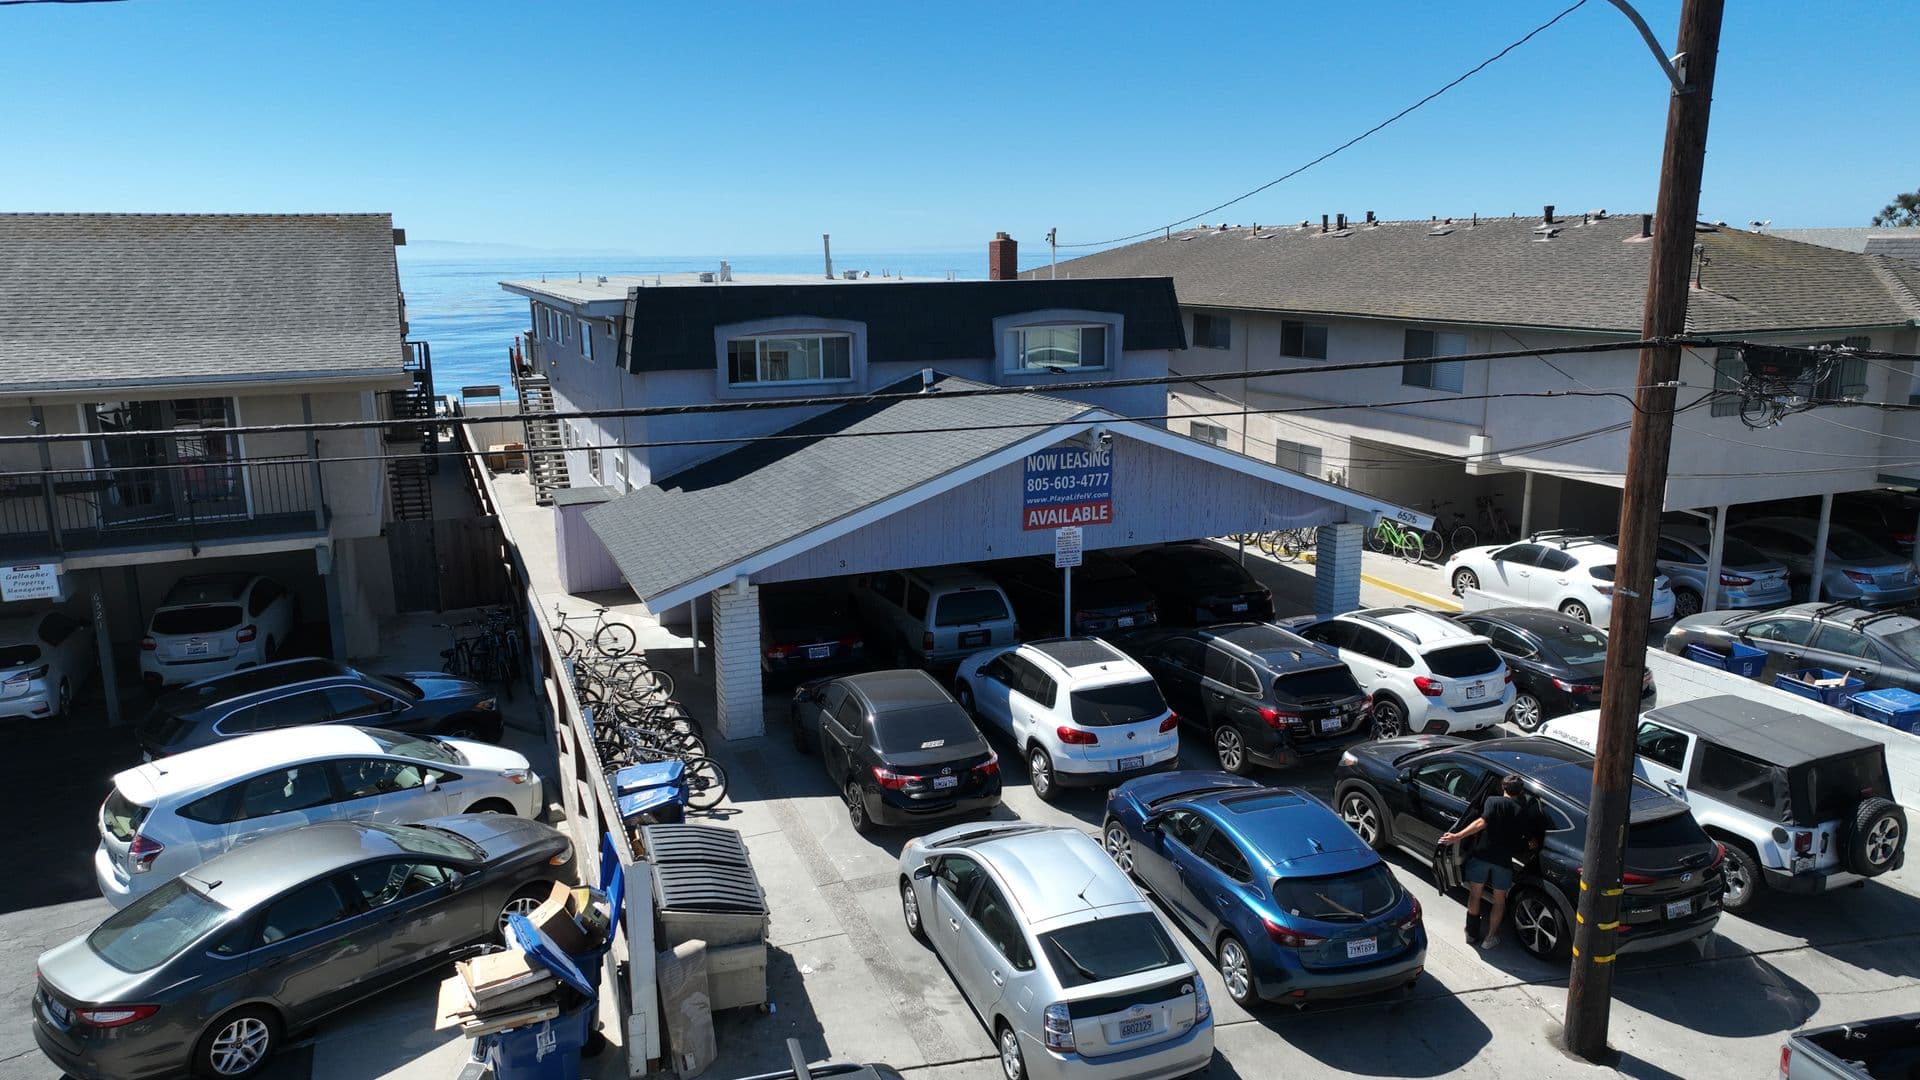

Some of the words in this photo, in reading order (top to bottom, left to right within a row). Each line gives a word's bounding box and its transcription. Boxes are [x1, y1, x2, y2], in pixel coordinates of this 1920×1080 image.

[1027, 454, 1057, 472] NOW
[1060, 451, 1110, 469] LEASING
[1027, 473, 1109, 491] 805-603-4777
[1026, 492, 1109, 504] www.PlayaLifeIV.com
[1028, 505, 1108, 526] AVAILABLE
[1397, 511, 1417, 523] 6525
[1128, 531, 1134, 539] 2
[839, 560, 846, 568] 3
[5, 571, 49, 581] Gallagher
[8, 585, 54, 593] Management
